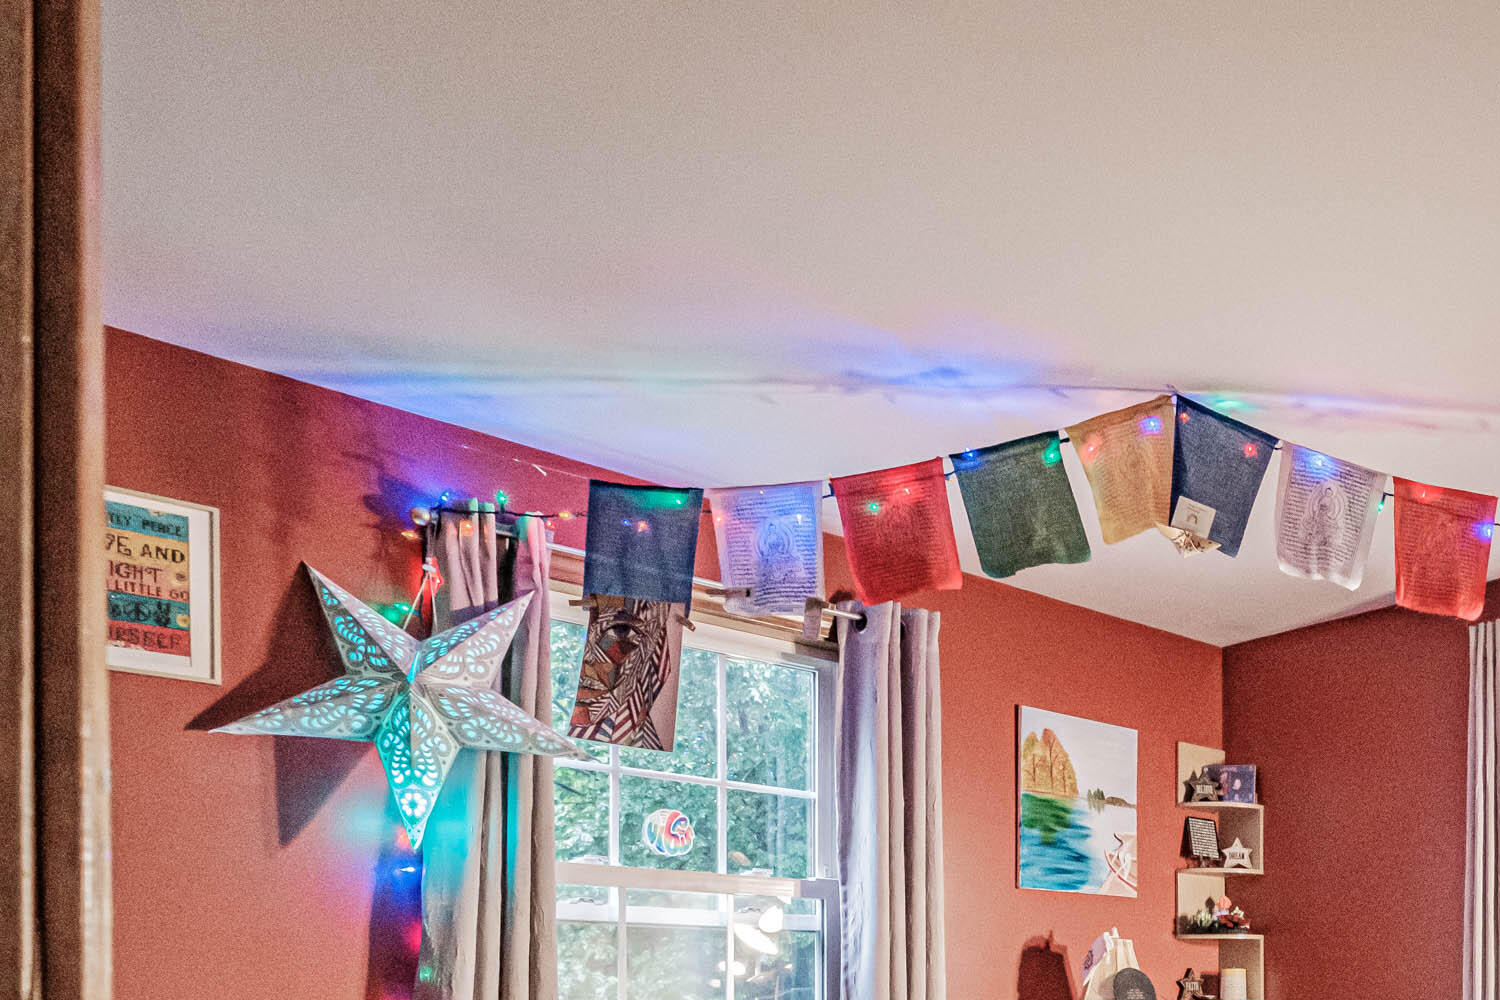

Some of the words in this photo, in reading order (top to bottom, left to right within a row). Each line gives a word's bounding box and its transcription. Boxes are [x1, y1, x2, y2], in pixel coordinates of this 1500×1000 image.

[140, 543, 185, 564] AND
[109, 560, 163, 583] IGHT
[115, 579, 161, 597] LITTLE
